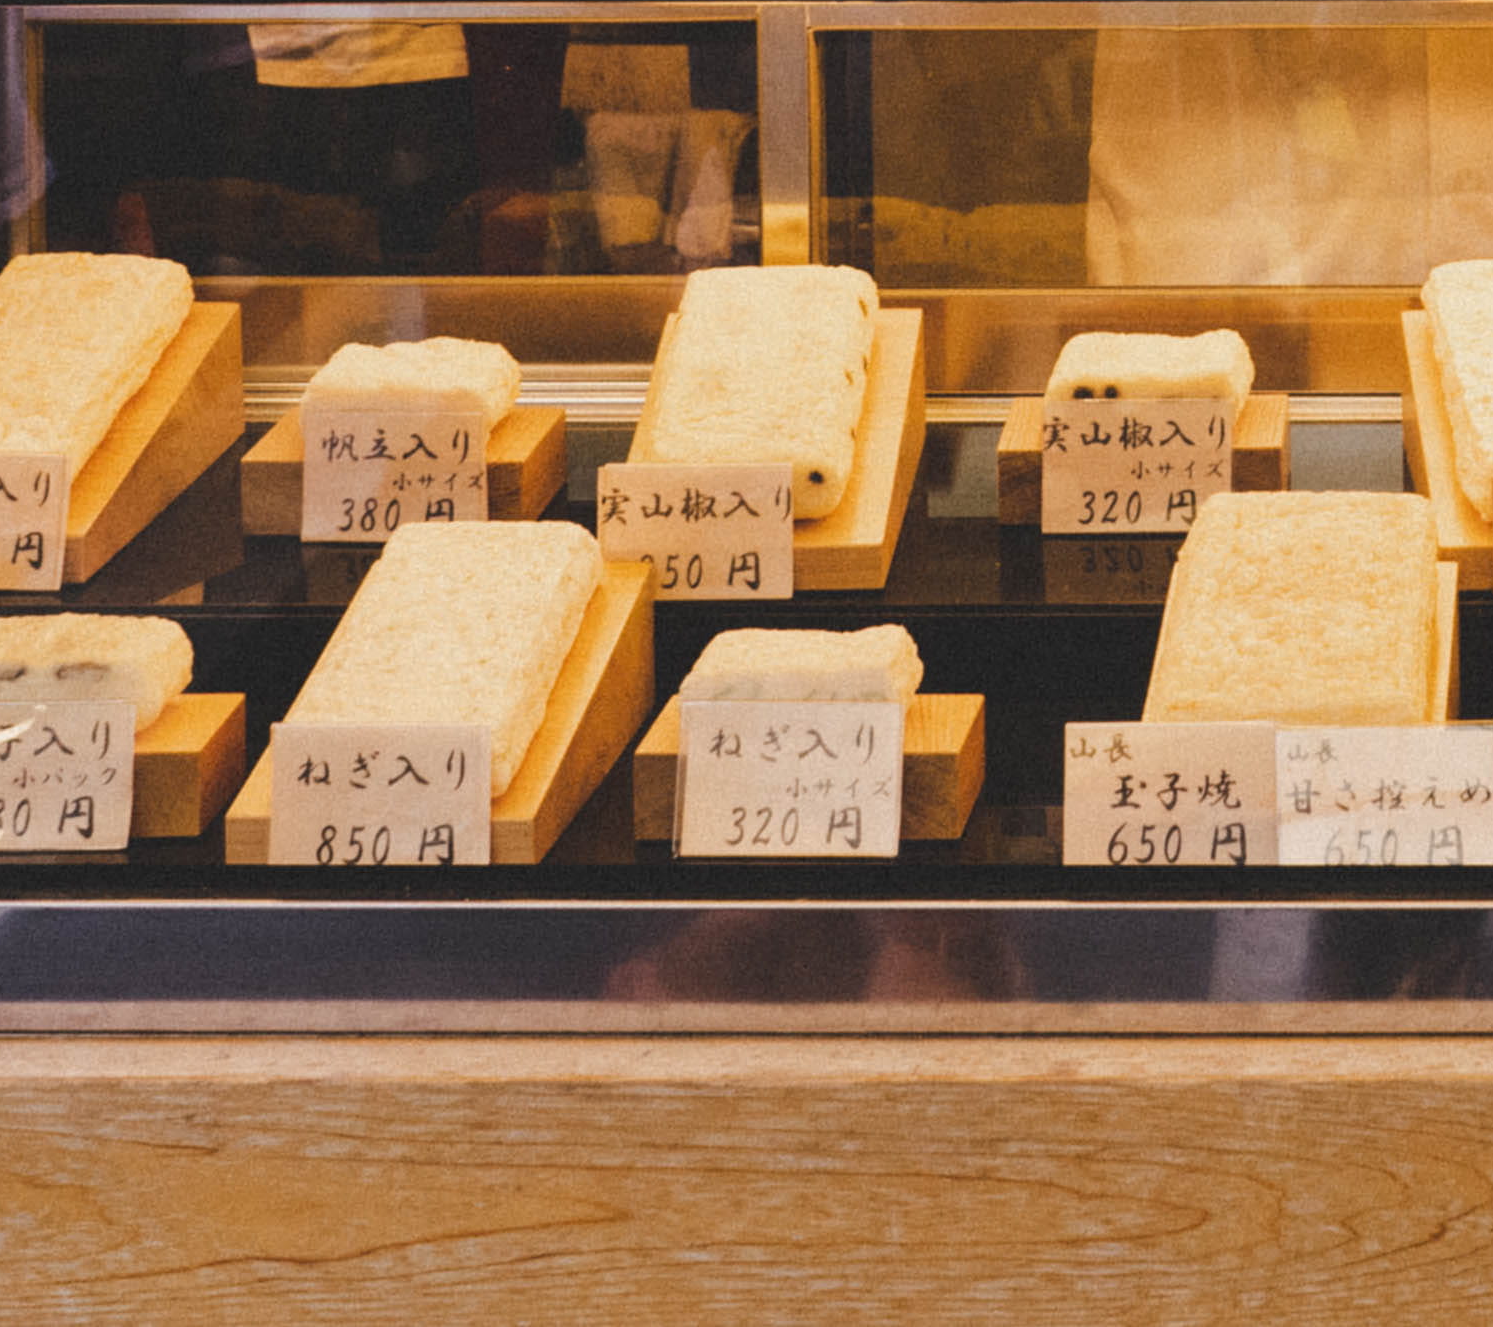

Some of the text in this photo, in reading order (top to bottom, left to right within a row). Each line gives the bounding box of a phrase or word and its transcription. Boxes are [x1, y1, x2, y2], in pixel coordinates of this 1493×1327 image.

[322, 429, 469, 463] 帆立入り
[640, 552, 760, 590] 50円
[710, 722, 875, 764] ねぎ入り
[1070, 733, 1133, 763] 山長
[298, 749, 465, 790] ねぎ入り
[1110, 769, 1243, 811] 玉子焼
[1286, 776, 1493, 815] 甘さ控えめ
[317, 824, 454, 865] 850円
[726, 806, 861, 850] 320円
[1107, 821, 1247, 866] 650円
